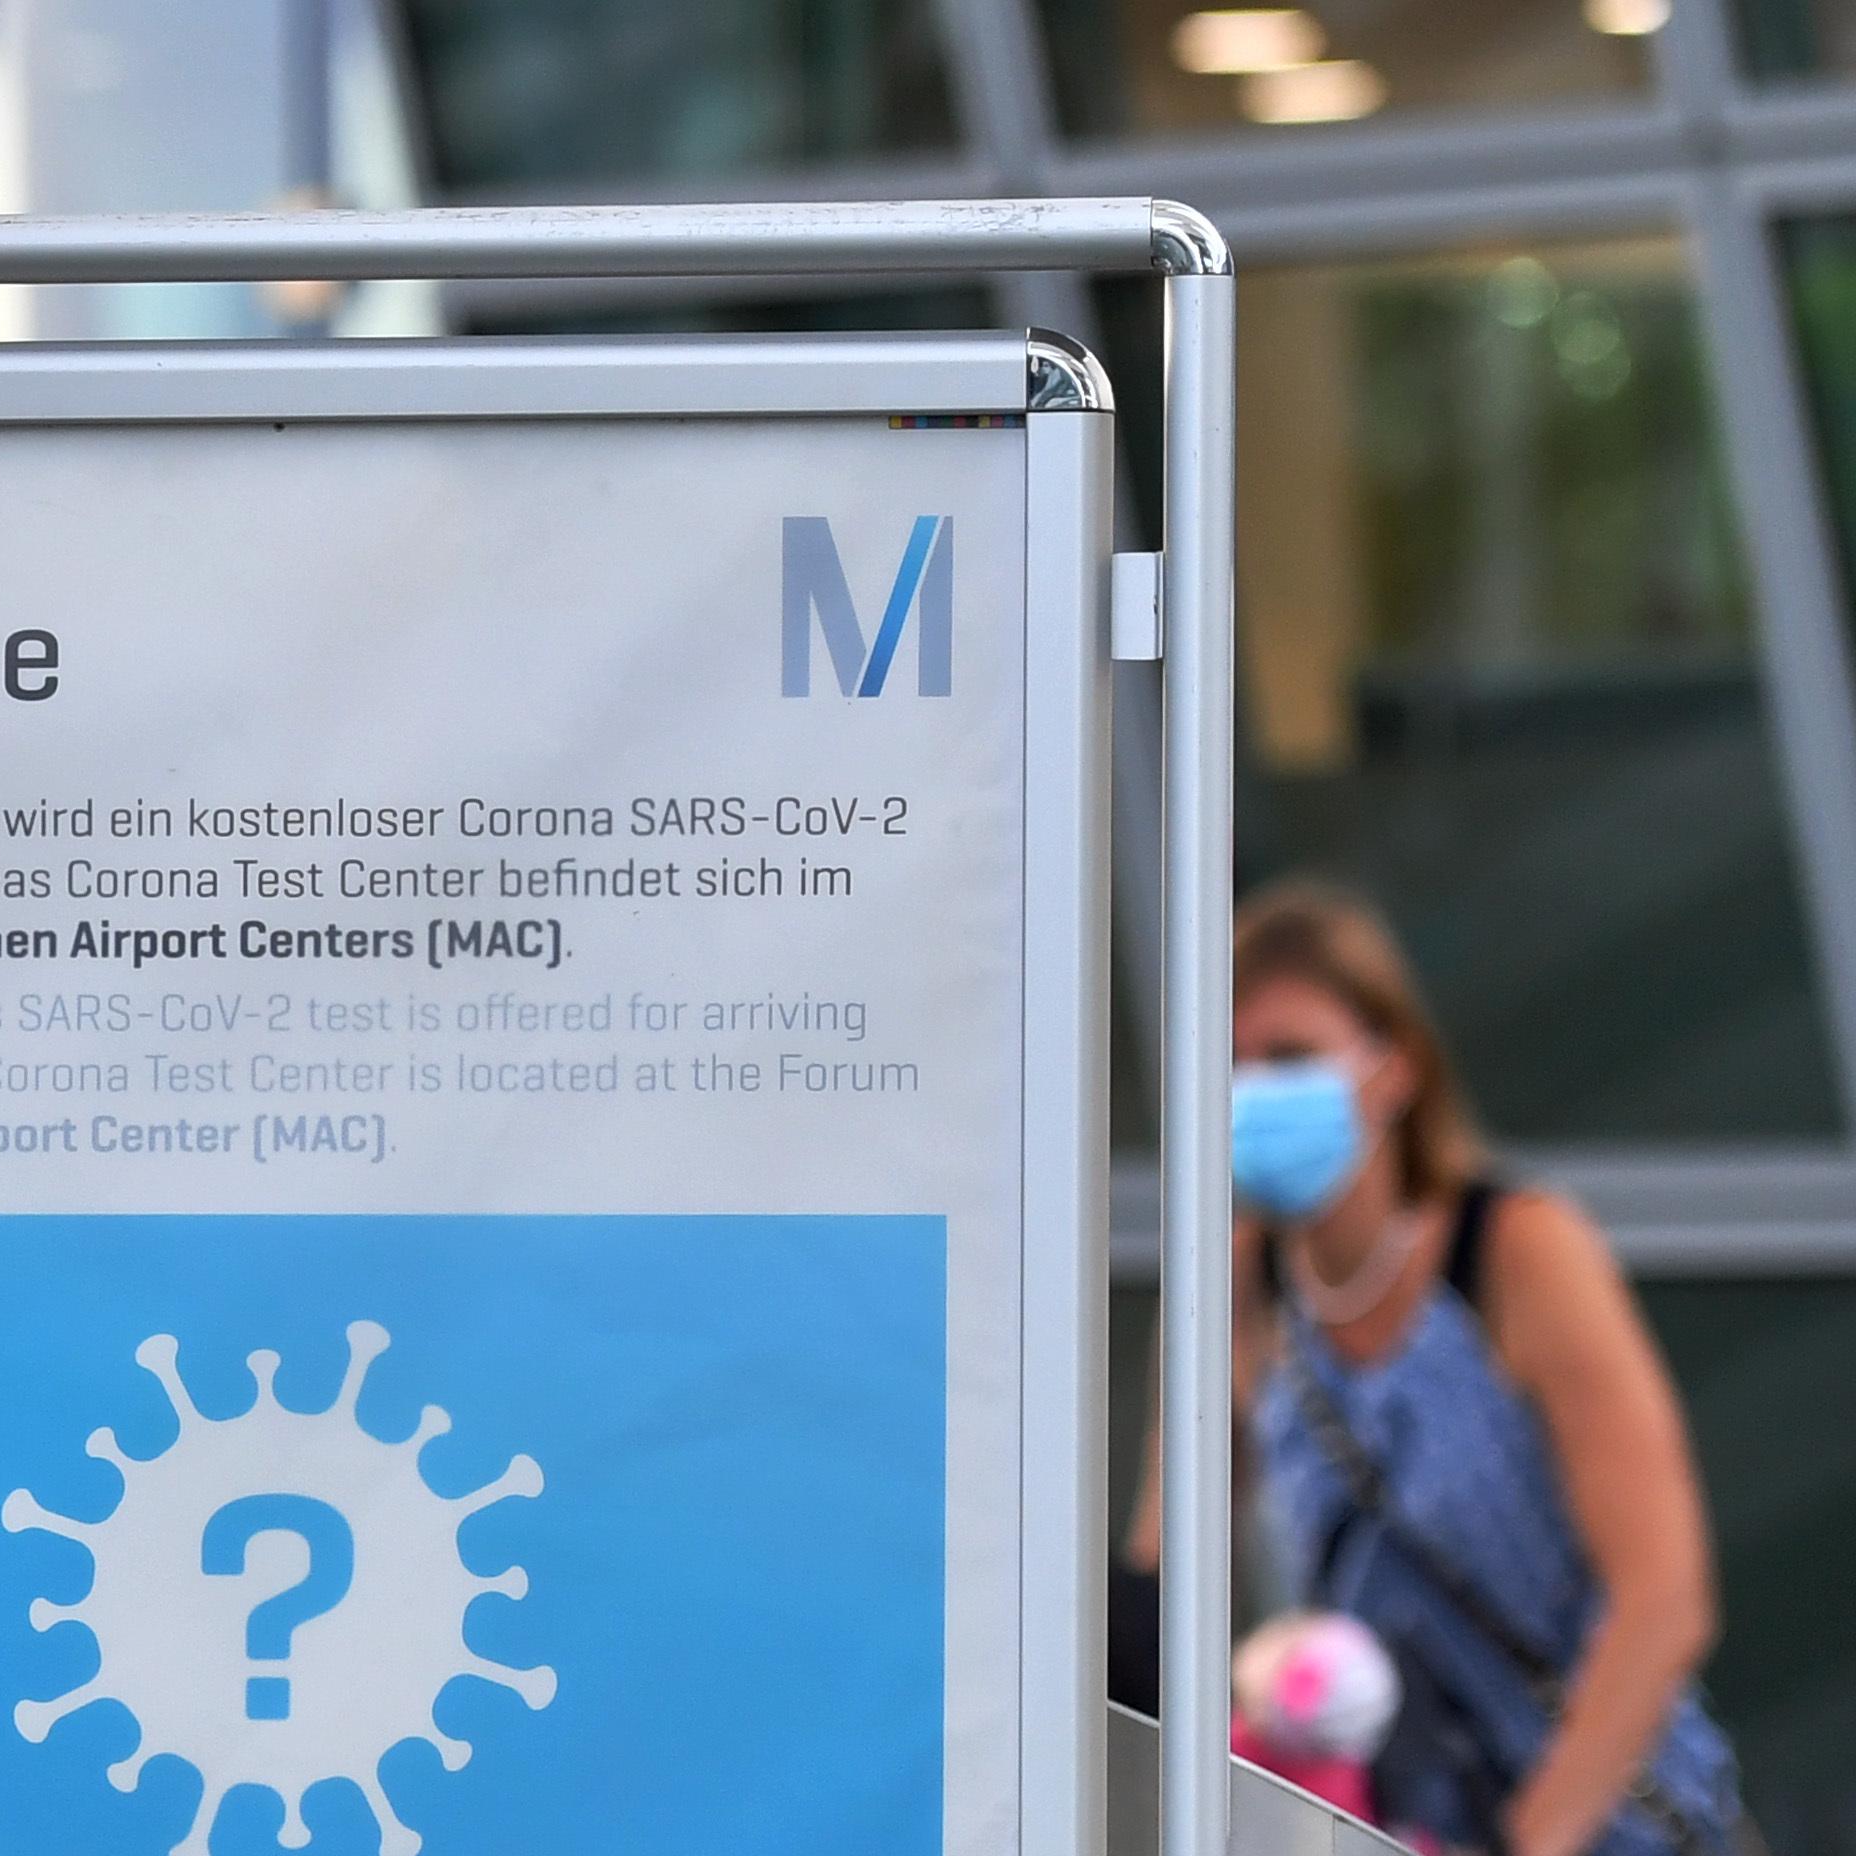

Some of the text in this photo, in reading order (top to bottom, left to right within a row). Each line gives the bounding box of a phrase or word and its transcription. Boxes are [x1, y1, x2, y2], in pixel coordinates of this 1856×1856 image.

[3, 798, 94, 839] wird
[111, 798, 173, 839] ein
[190, 798, 446, 839] kostenloser
[460, 798, 614, 839] Corona
[631, 797, 909, 838] SARS-CoV-2
[68, 860, 219, 900] Corona
[233, 860, 326, 900] Test
[341, 859, 485, 900] Center
[500, 858, 682, 900] befindet
[696, 858, 784, 899] sich
[801, 857, 853, 898] im
[70, 920, 229, 969] Airport
[240, 920, 415, 959] Centers
[19, 994, 293, 1034] SARS-CoV-2
[308, 996, 394, 1034] test
[408, 994, 442, 1033] is
[457, 993, 613, 1033] offered
[628, 993, 690, 1033] for
[704, 992, 868, 1043] arriving
[145, 1055, 235, 1094] Test
[250, 1054, 395, 1094] Center
[409, 1054, 443, 1094] is
[458, 1054, 619, 1094] located
[635, 1056, 678, 1094] at
[691, 1053, 762, 1094] the
[779, 1053, 920, 1093] Forum
[91, 1115, 242, 1154] Center
